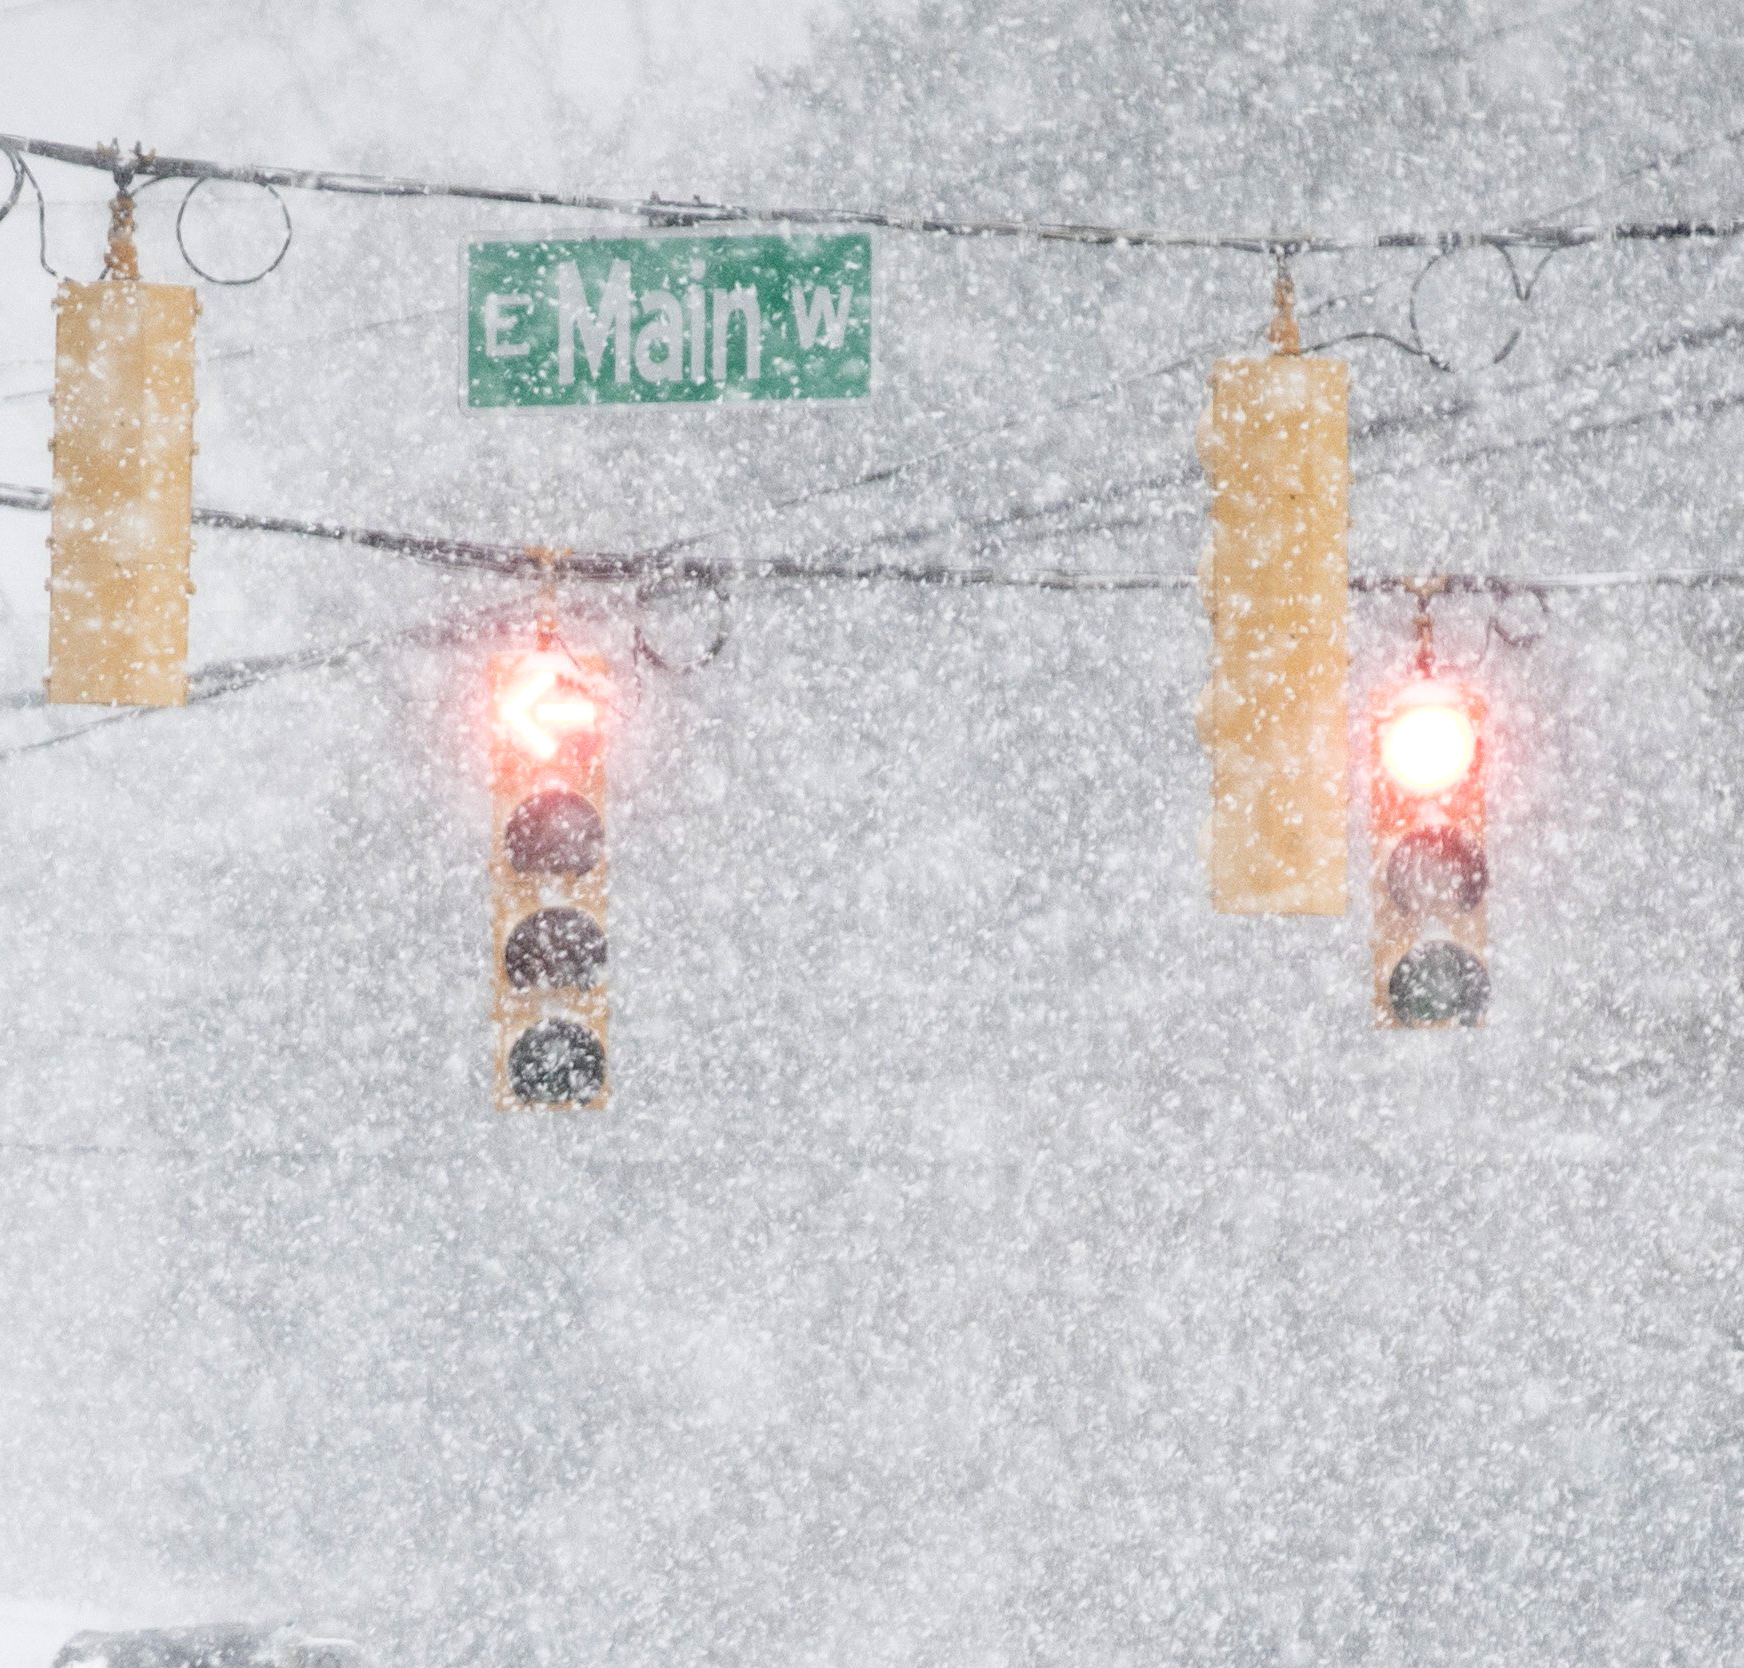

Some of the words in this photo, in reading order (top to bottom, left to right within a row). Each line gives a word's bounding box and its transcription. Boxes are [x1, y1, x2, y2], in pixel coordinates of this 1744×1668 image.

[485, 292, 532, 358] E
[559, 257, 761, 385] Main
[790, 283, 854, 351] W
